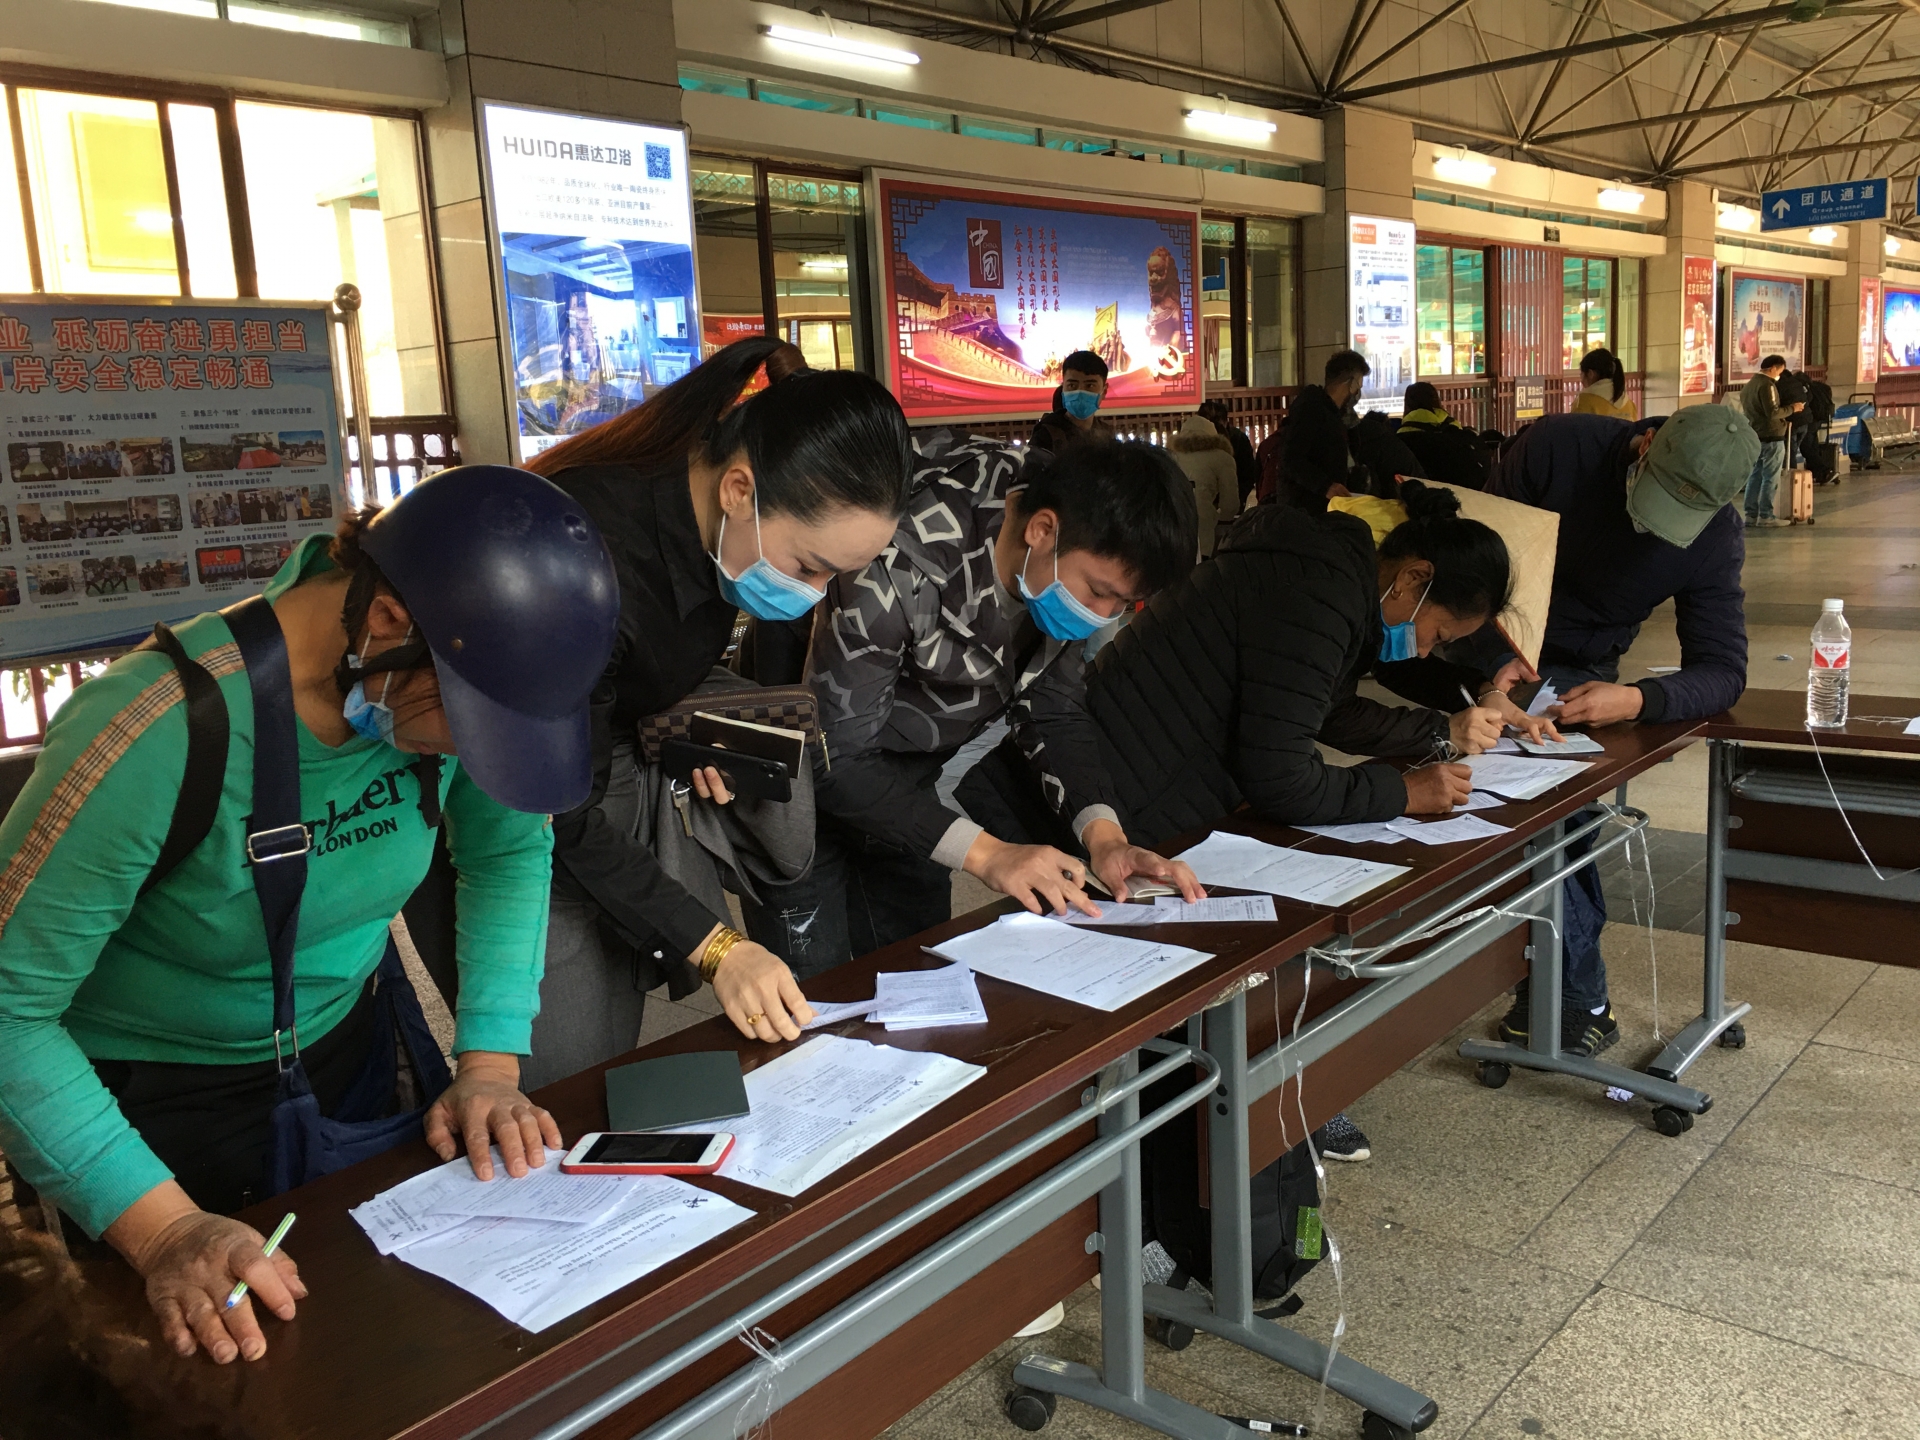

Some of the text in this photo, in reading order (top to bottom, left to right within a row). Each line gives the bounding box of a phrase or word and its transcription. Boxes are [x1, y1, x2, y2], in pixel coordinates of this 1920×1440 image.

[503, 136, 632, 166] HUIDA 惠达卫浴
[1801, 185, 1875, 206] 团队通道
[1812, 203, 1863, 214] Group channel
[0, 318, 308, 353] 业 砥砺奋进勇担当
[0, 355, 273, 392] 岸安全稳定畅通
[317, 816, 398, 857] LONDON
